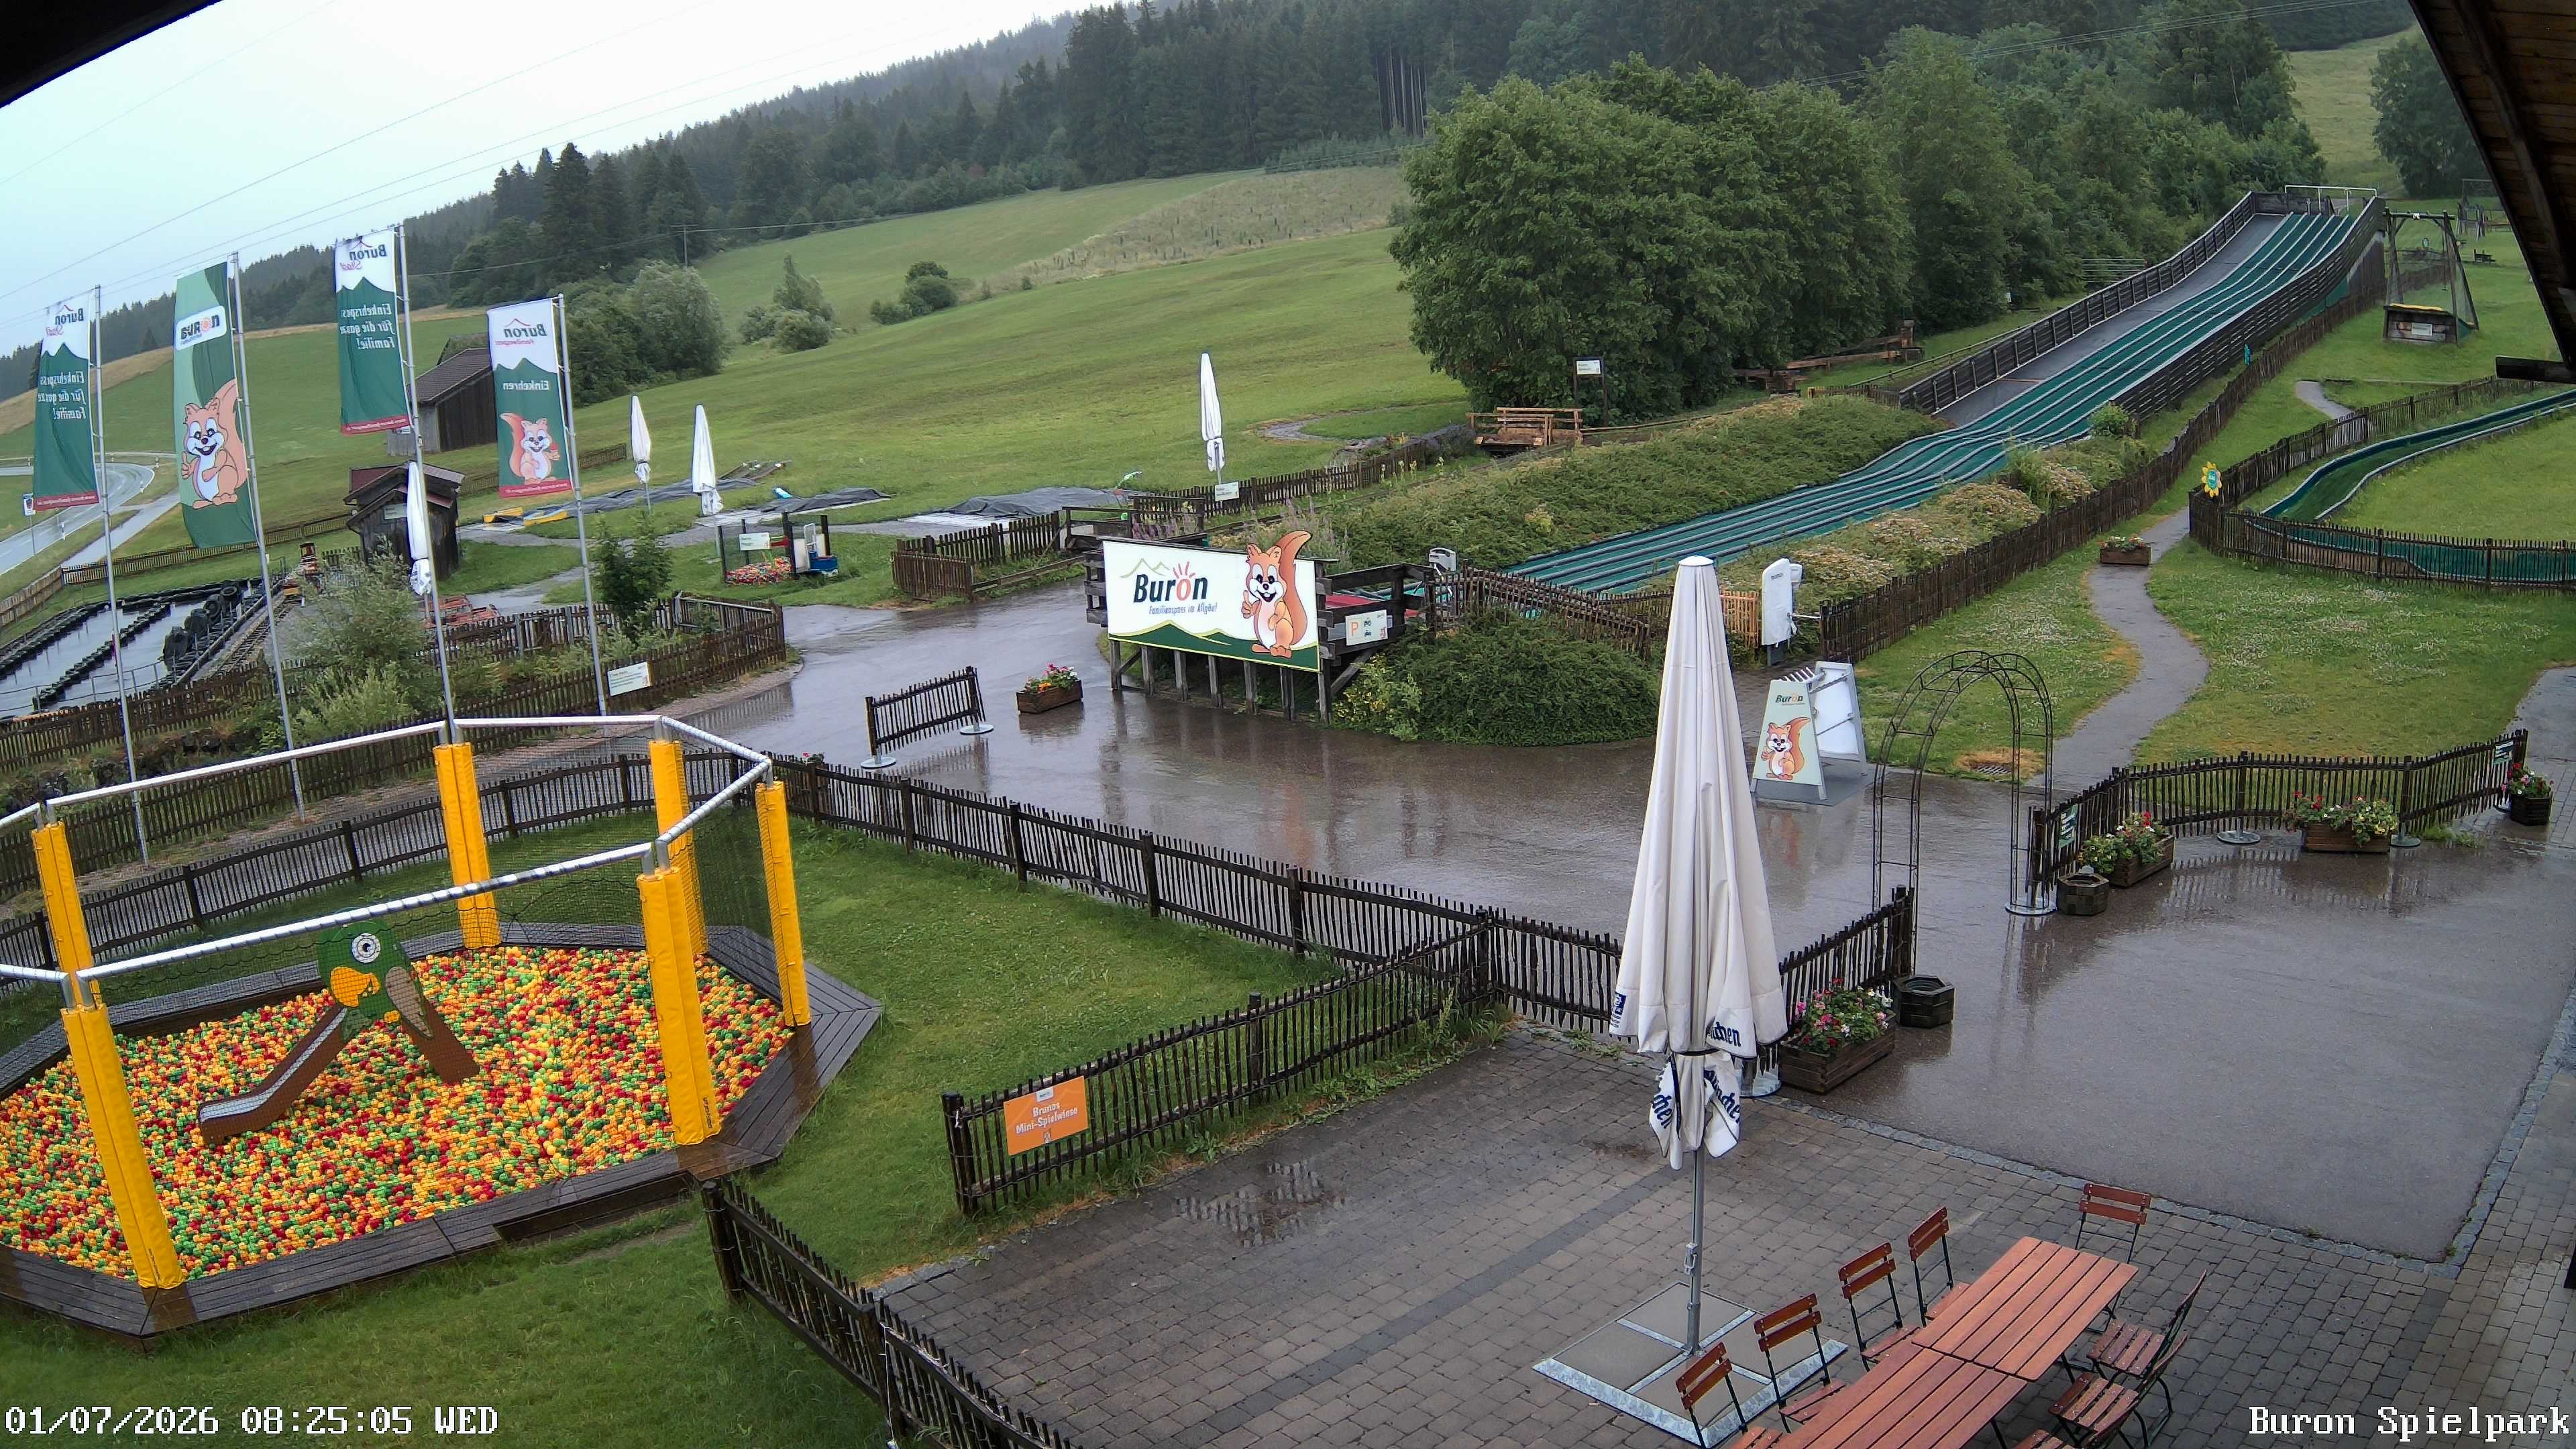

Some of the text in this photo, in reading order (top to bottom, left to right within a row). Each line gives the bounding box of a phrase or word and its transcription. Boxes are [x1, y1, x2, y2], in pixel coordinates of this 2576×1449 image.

[1133, 574, 1208, 602] Buron
[1148, 605, 1186, 615] Familienspass
[1775, 694, 1803, 703] Buron
[1033, 1102, 1060, 1117] Brunos
[1016, 1108, 1077, 1134] Mini-Spielwiese
